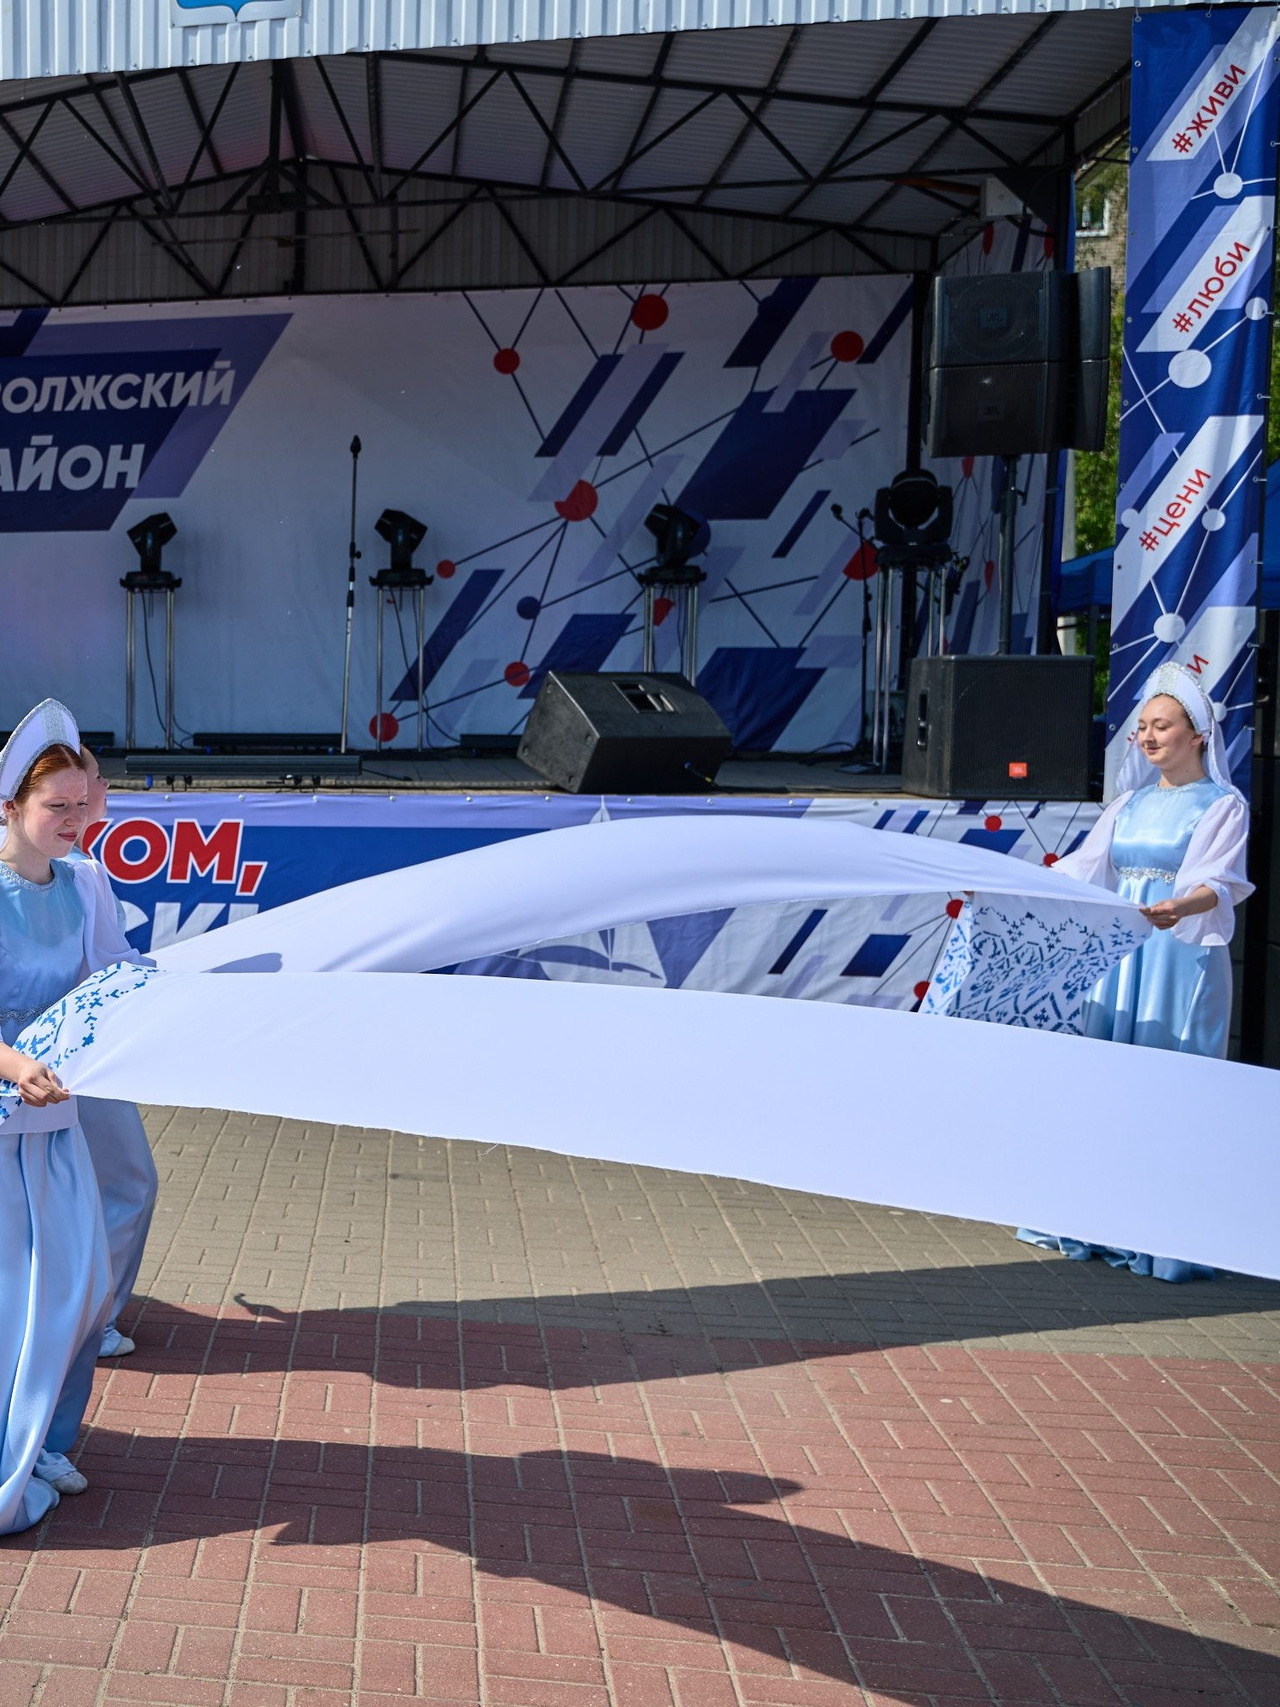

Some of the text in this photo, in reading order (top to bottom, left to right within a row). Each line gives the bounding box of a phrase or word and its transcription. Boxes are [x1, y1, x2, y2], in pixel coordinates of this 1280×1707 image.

[1172, 64, 1246, 153] #живи
[1173, 241, 1250, 333] #люби
[1140, 468, 1212, 551] #цени
